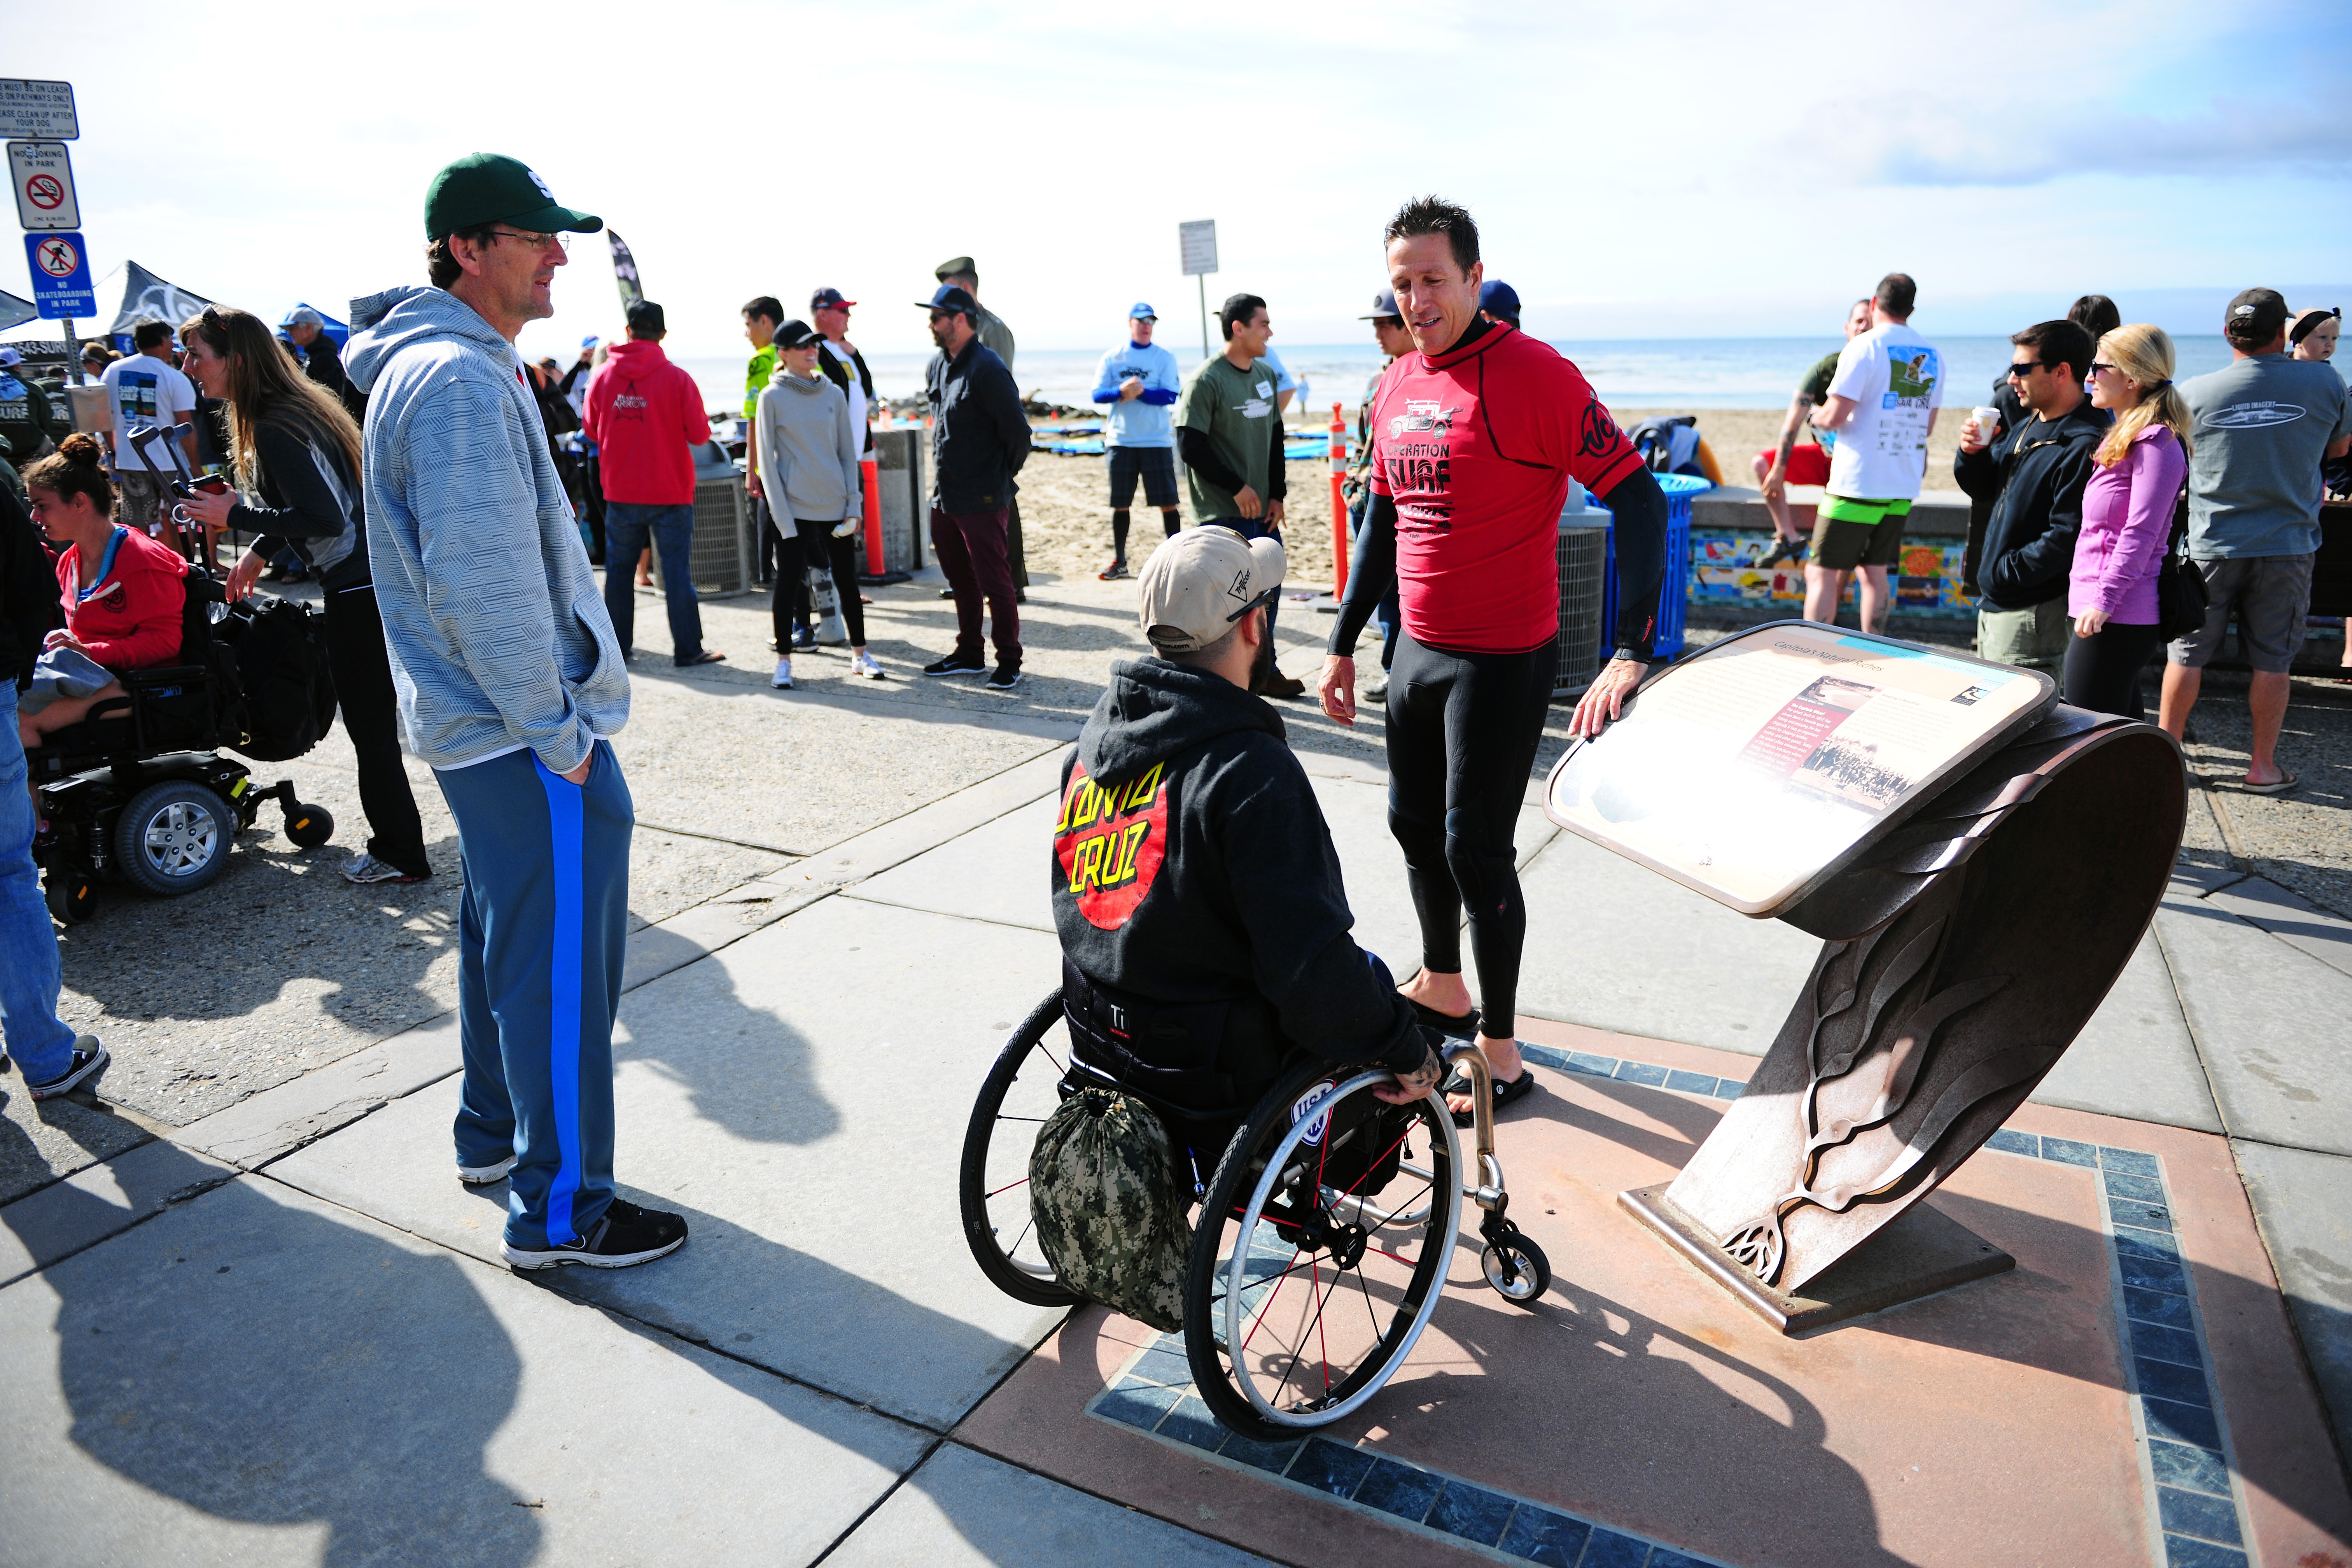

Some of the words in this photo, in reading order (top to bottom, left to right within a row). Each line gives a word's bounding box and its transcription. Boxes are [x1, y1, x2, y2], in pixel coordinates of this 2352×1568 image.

[35, 290, 92, 299] SKATEBOARDING
[611, 399, 648, 412] ARROW
[1388, 443, 1449, 458] OPERATION
[1389, 459, 1451, 494] SURF
[1235, 568, 1250, 594] Trijicon
[1774, 641, 1817, 656] Capitola's
[1816, 652, 1855, 664] Natural
[1852, 660, 1885, 672] Riches
[1910, 655, 1942, 665] SANCTUARY
[1069, 821, 1148, 893] CRUZ
[1111, 1004, 1124, 1030] Ti
